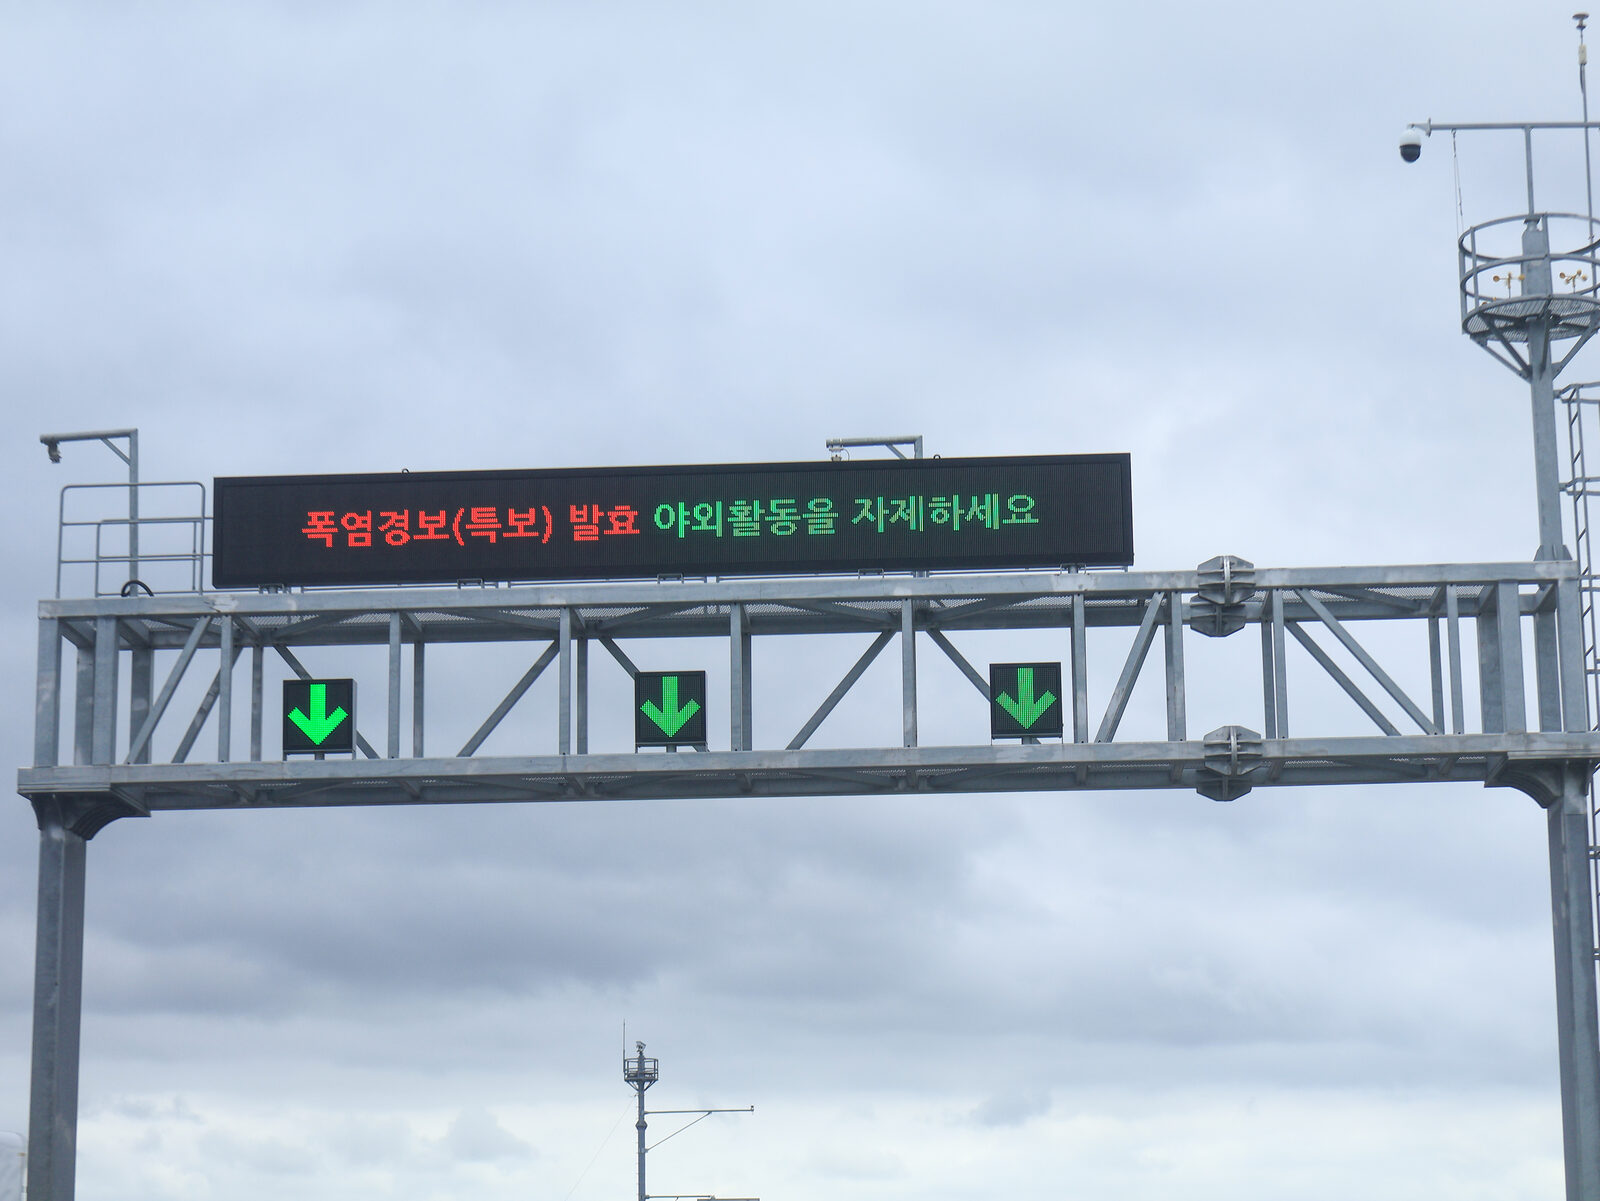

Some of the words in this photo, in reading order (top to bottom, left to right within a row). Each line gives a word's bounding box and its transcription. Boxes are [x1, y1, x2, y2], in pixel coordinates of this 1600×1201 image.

[301, 506, 552, 547] 폭염경보(특보)
[569, 503, 640, 541] 발효
[652, 496, 839, 538] 야외활동을
[850, 493, 1040, 533] 자제하세요
